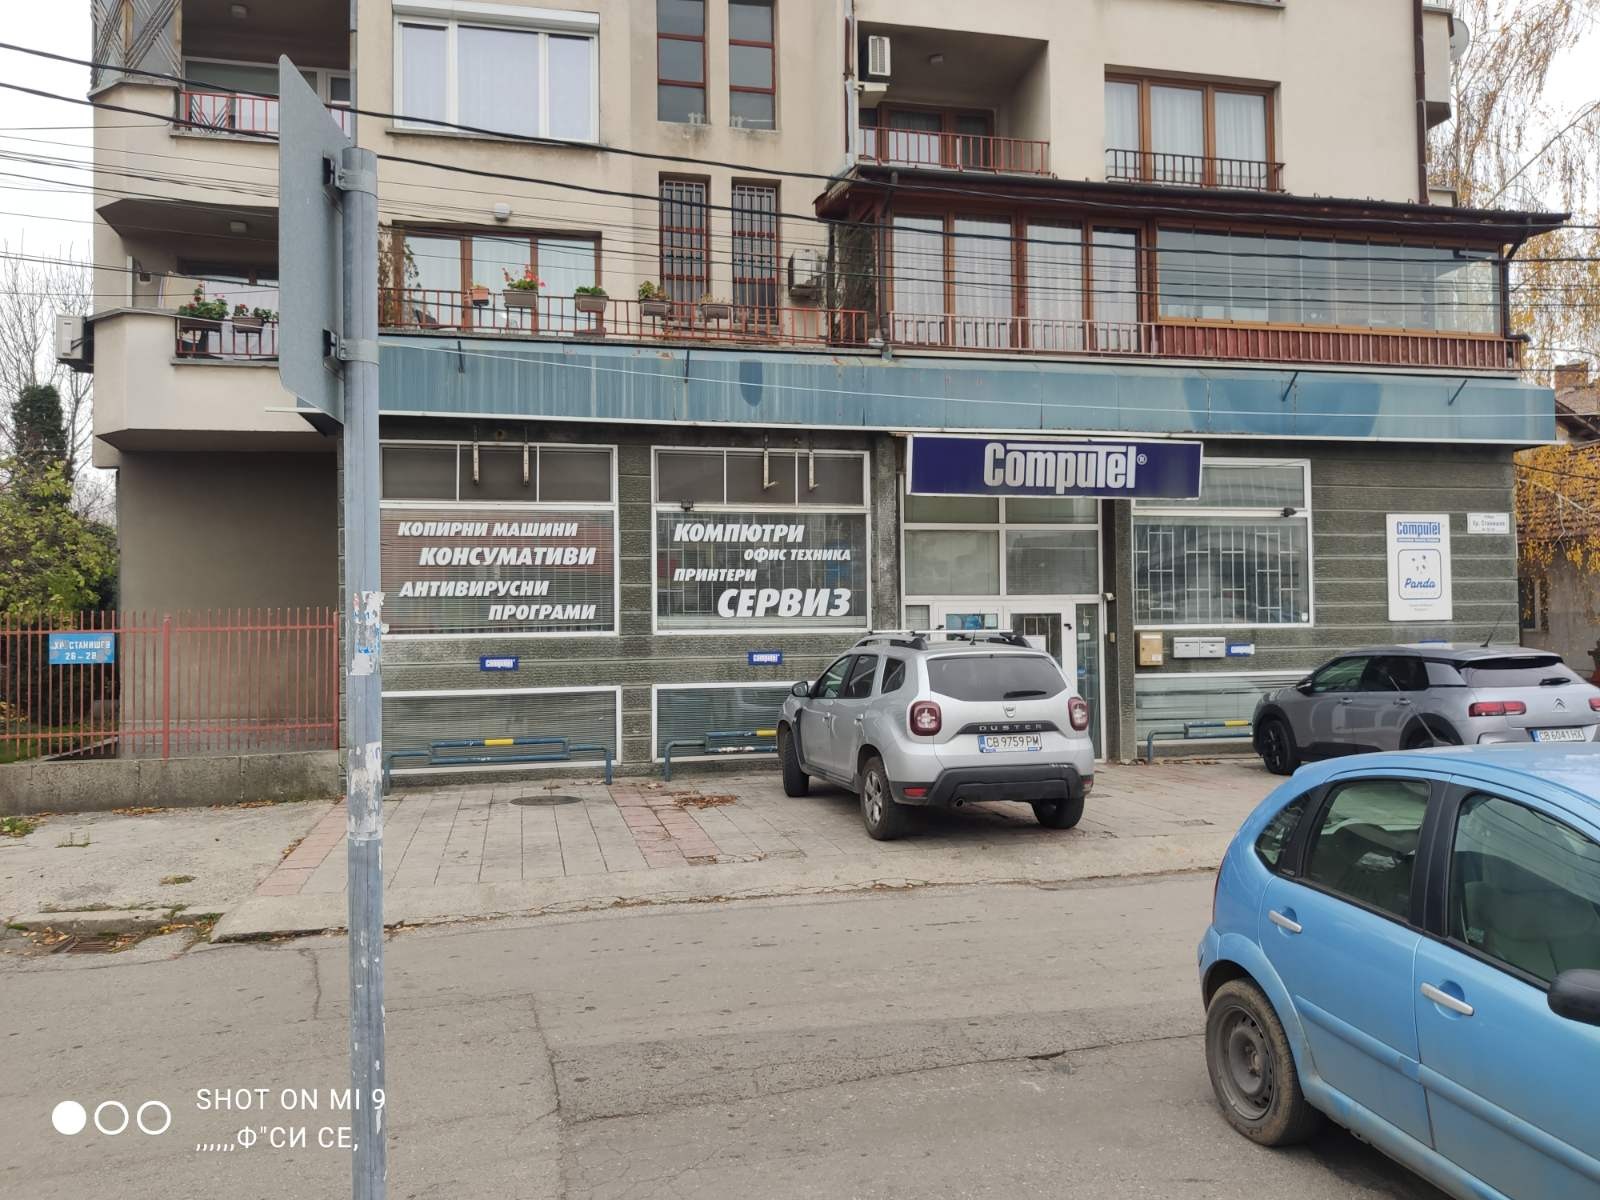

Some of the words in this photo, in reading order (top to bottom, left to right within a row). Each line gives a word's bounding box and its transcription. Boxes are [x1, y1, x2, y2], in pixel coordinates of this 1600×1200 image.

[398, 521, 489, 537] КОПИРНИ
[492, 522, 579, 537] МАШИНИ
[673, 523, 805, 543] КОМПЮТРИ
[419, 546, 597, 566] КОНСУМАТИВИ
[743, 548, 787, 562] ОФИС
[790, 549, 851, 561] ТЕХНИКА
[673, 568, 758, 582] ПРИНТЕРИ
[1404, 577, 1437, 589] Panda
[399, 580, 550, 597] АНТИВИРУСНИ
[717, 588, 851, 618] СЕРВИЗ
[488, 604, 597, 621] ПРОГРАМИ
